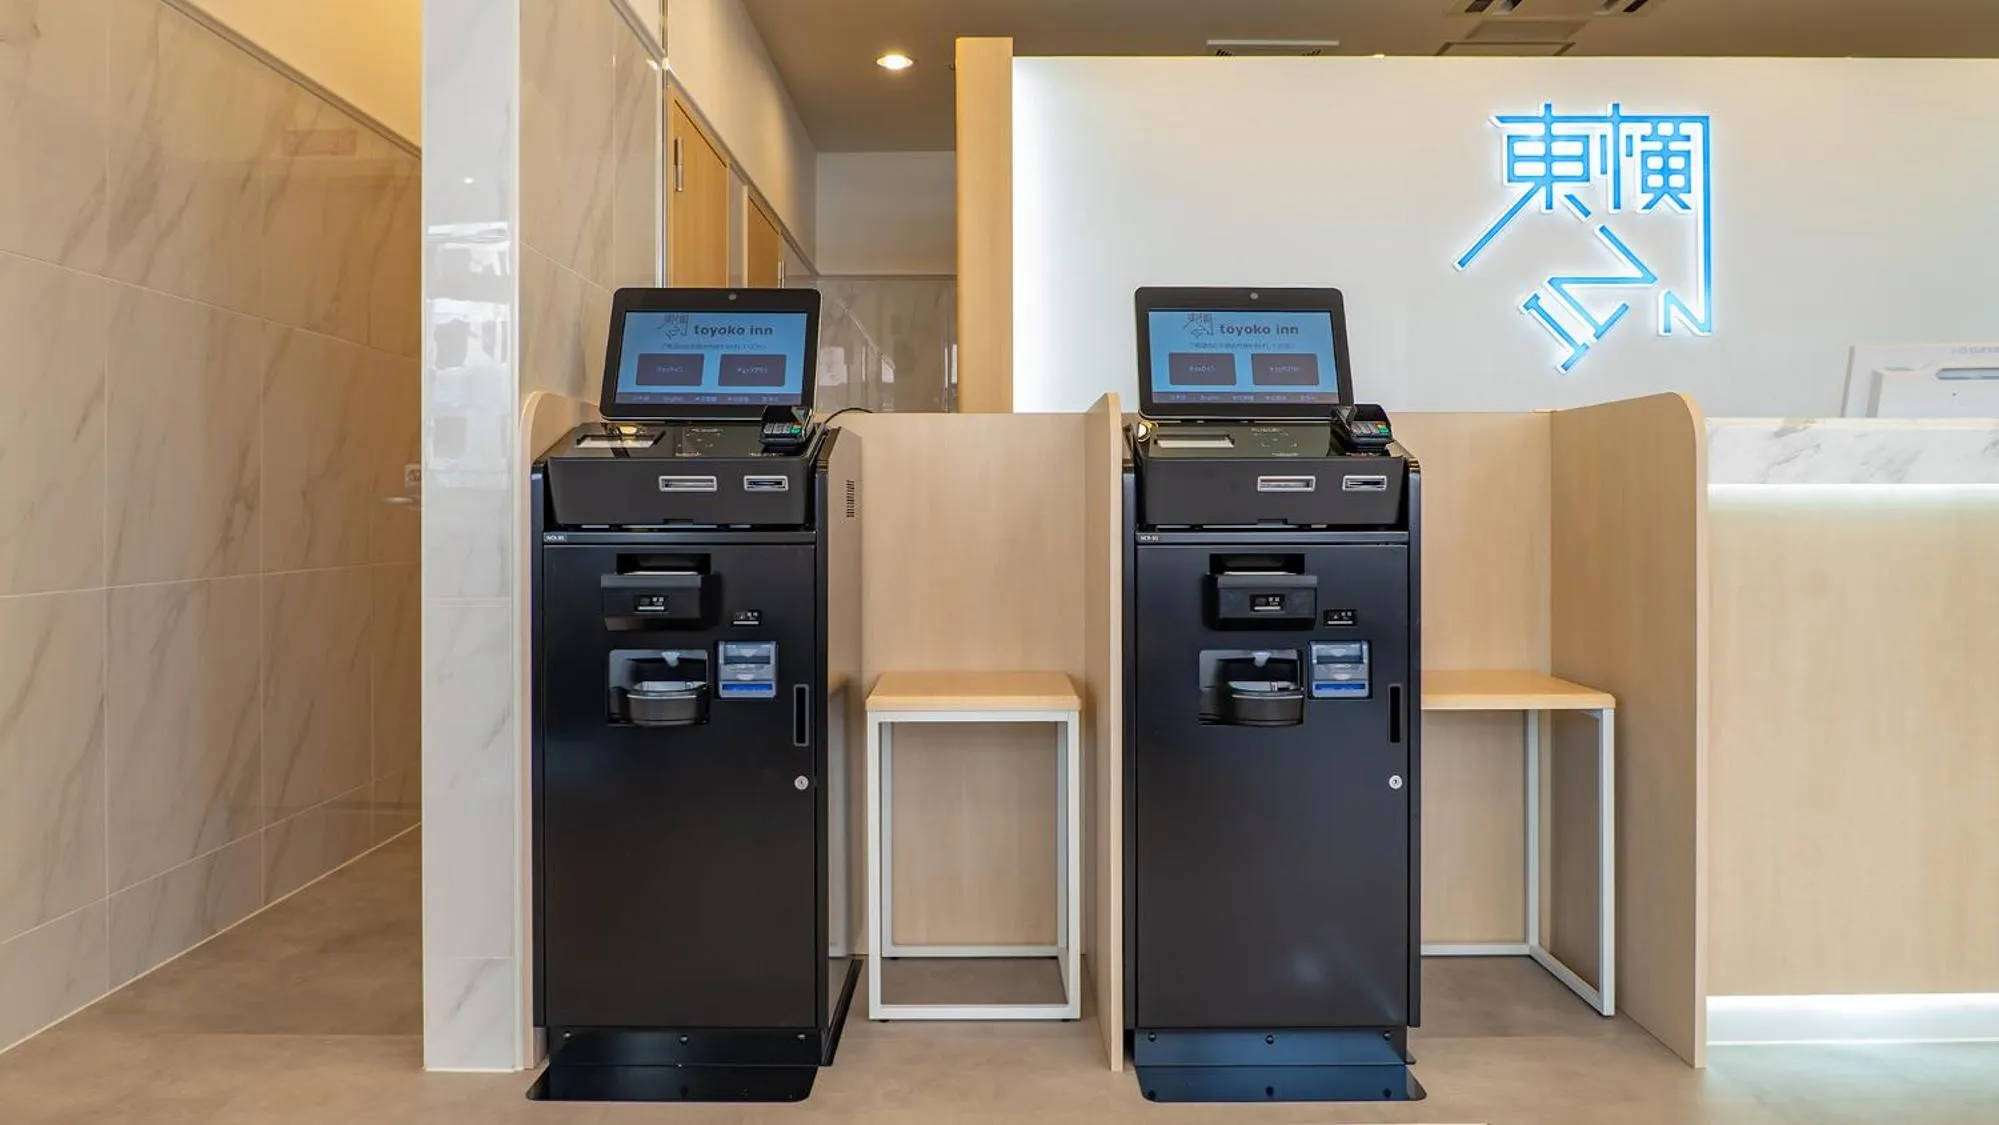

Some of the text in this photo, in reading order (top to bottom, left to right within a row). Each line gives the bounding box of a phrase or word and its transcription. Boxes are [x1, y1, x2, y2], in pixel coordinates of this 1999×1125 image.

[693, 325, 745, 337] toyoko
[750, 325, 773, 335] inn
[1220, 324, 1270, 336] toyoko
[1276, 323, 1299, 335] inn
